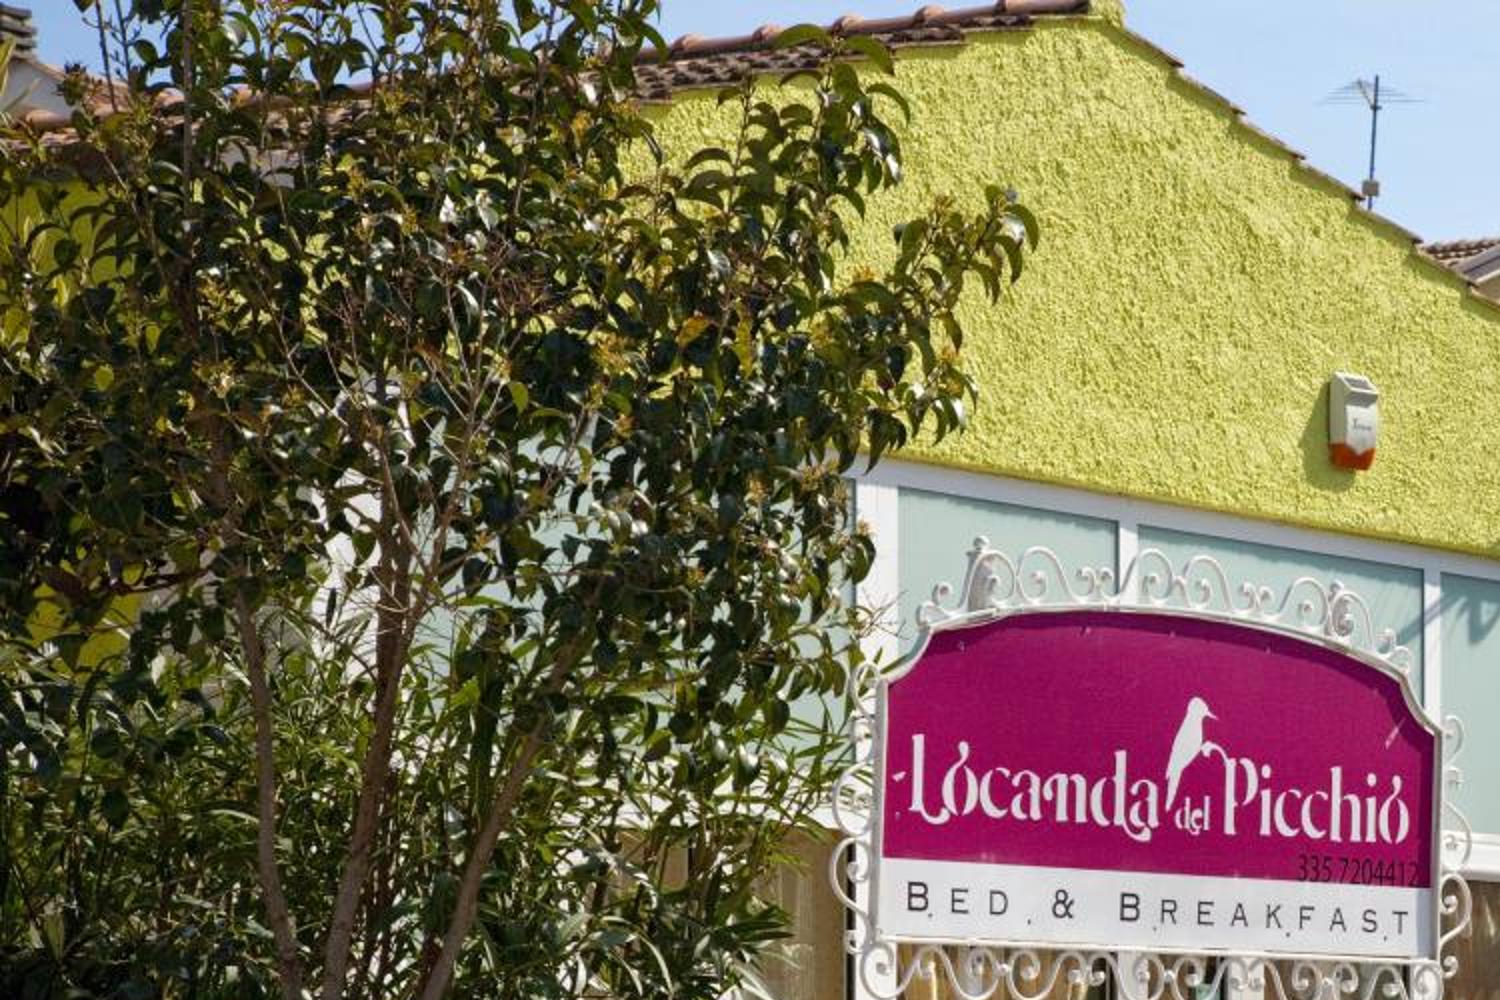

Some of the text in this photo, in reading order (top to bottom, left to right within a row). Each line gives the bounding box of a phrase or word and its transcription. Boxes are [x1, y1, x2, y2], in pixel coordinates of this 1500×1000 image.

[908, 733, 1411, 845] Locanda del Picchio
[906, 880, 1410, 935] BED & BREAKFAST
